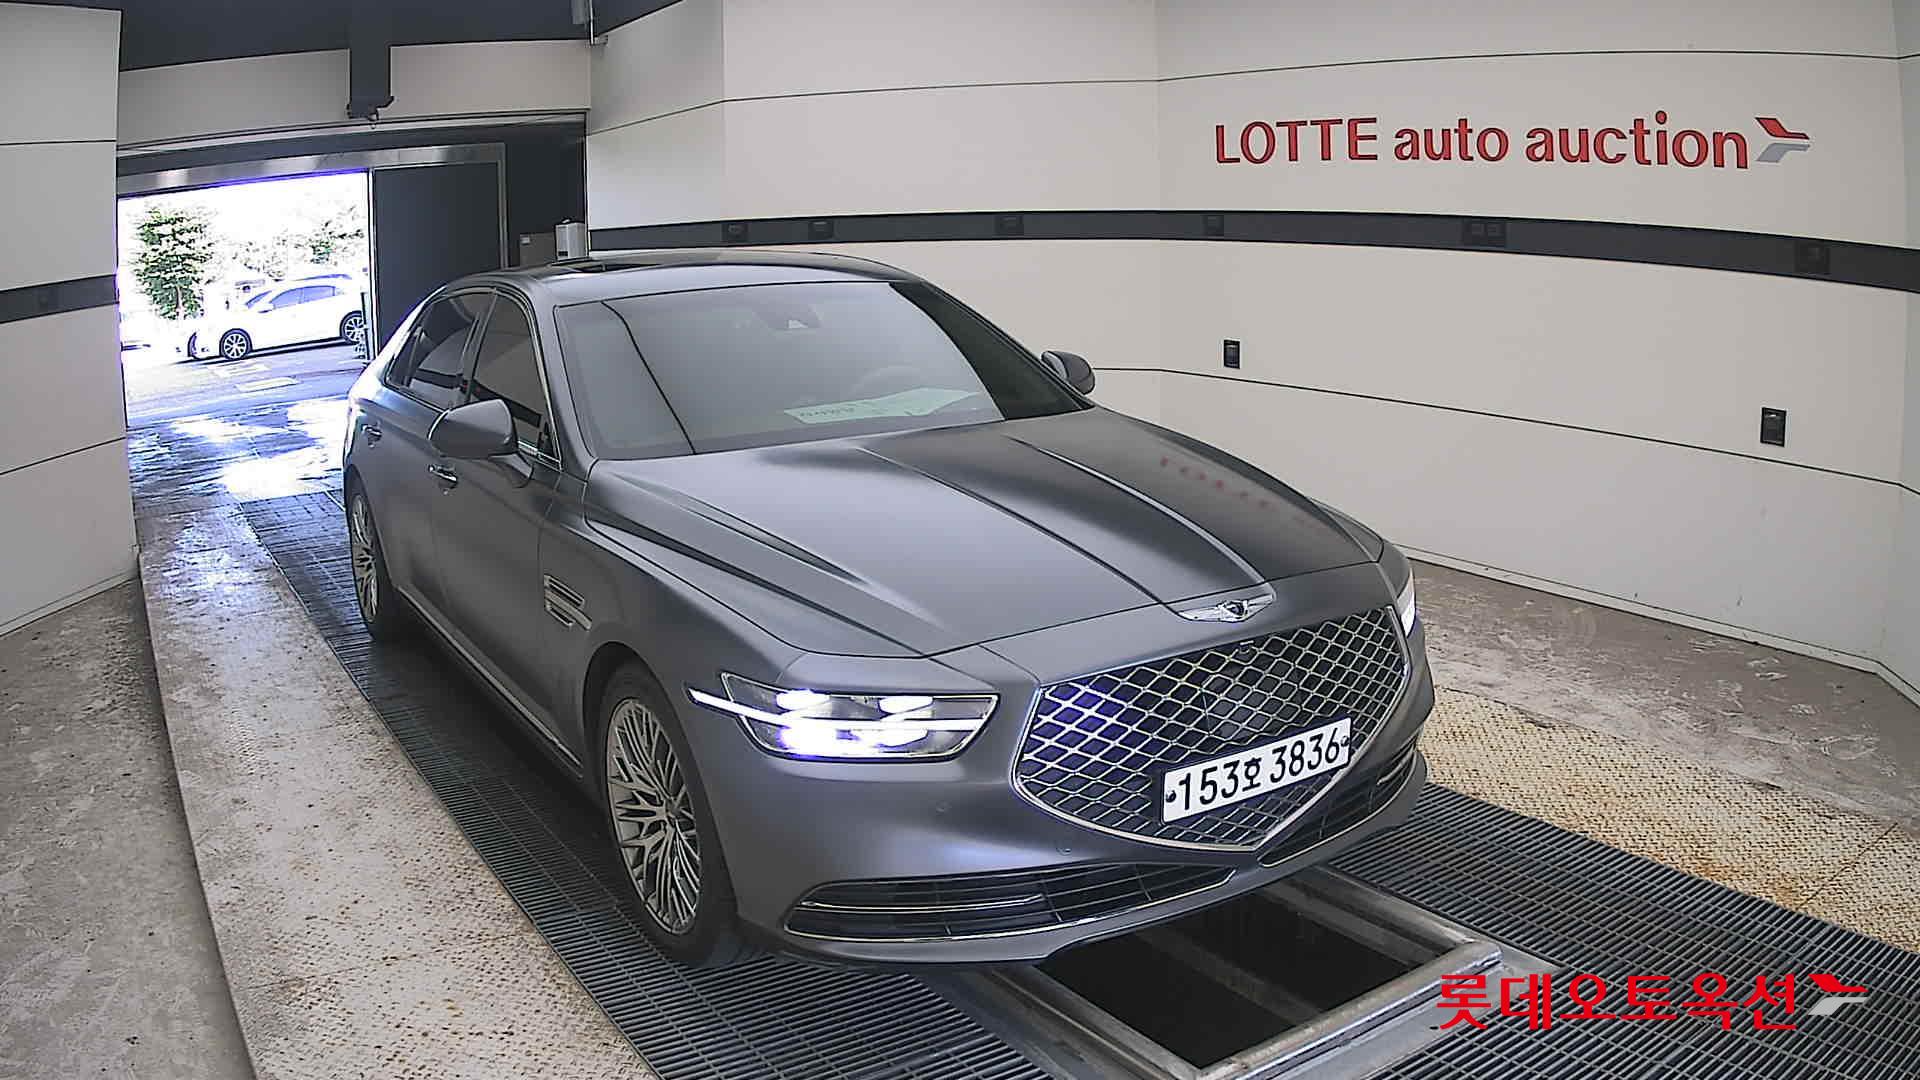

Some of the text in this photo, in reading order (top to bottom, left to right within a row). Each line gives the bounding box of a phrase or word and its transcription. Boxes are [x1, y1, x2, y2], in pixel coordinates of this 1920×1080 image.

[1215, 110, 1750, 170] LOTTE auto auction
[1178, 727, 1340, 811] 153호 3836
